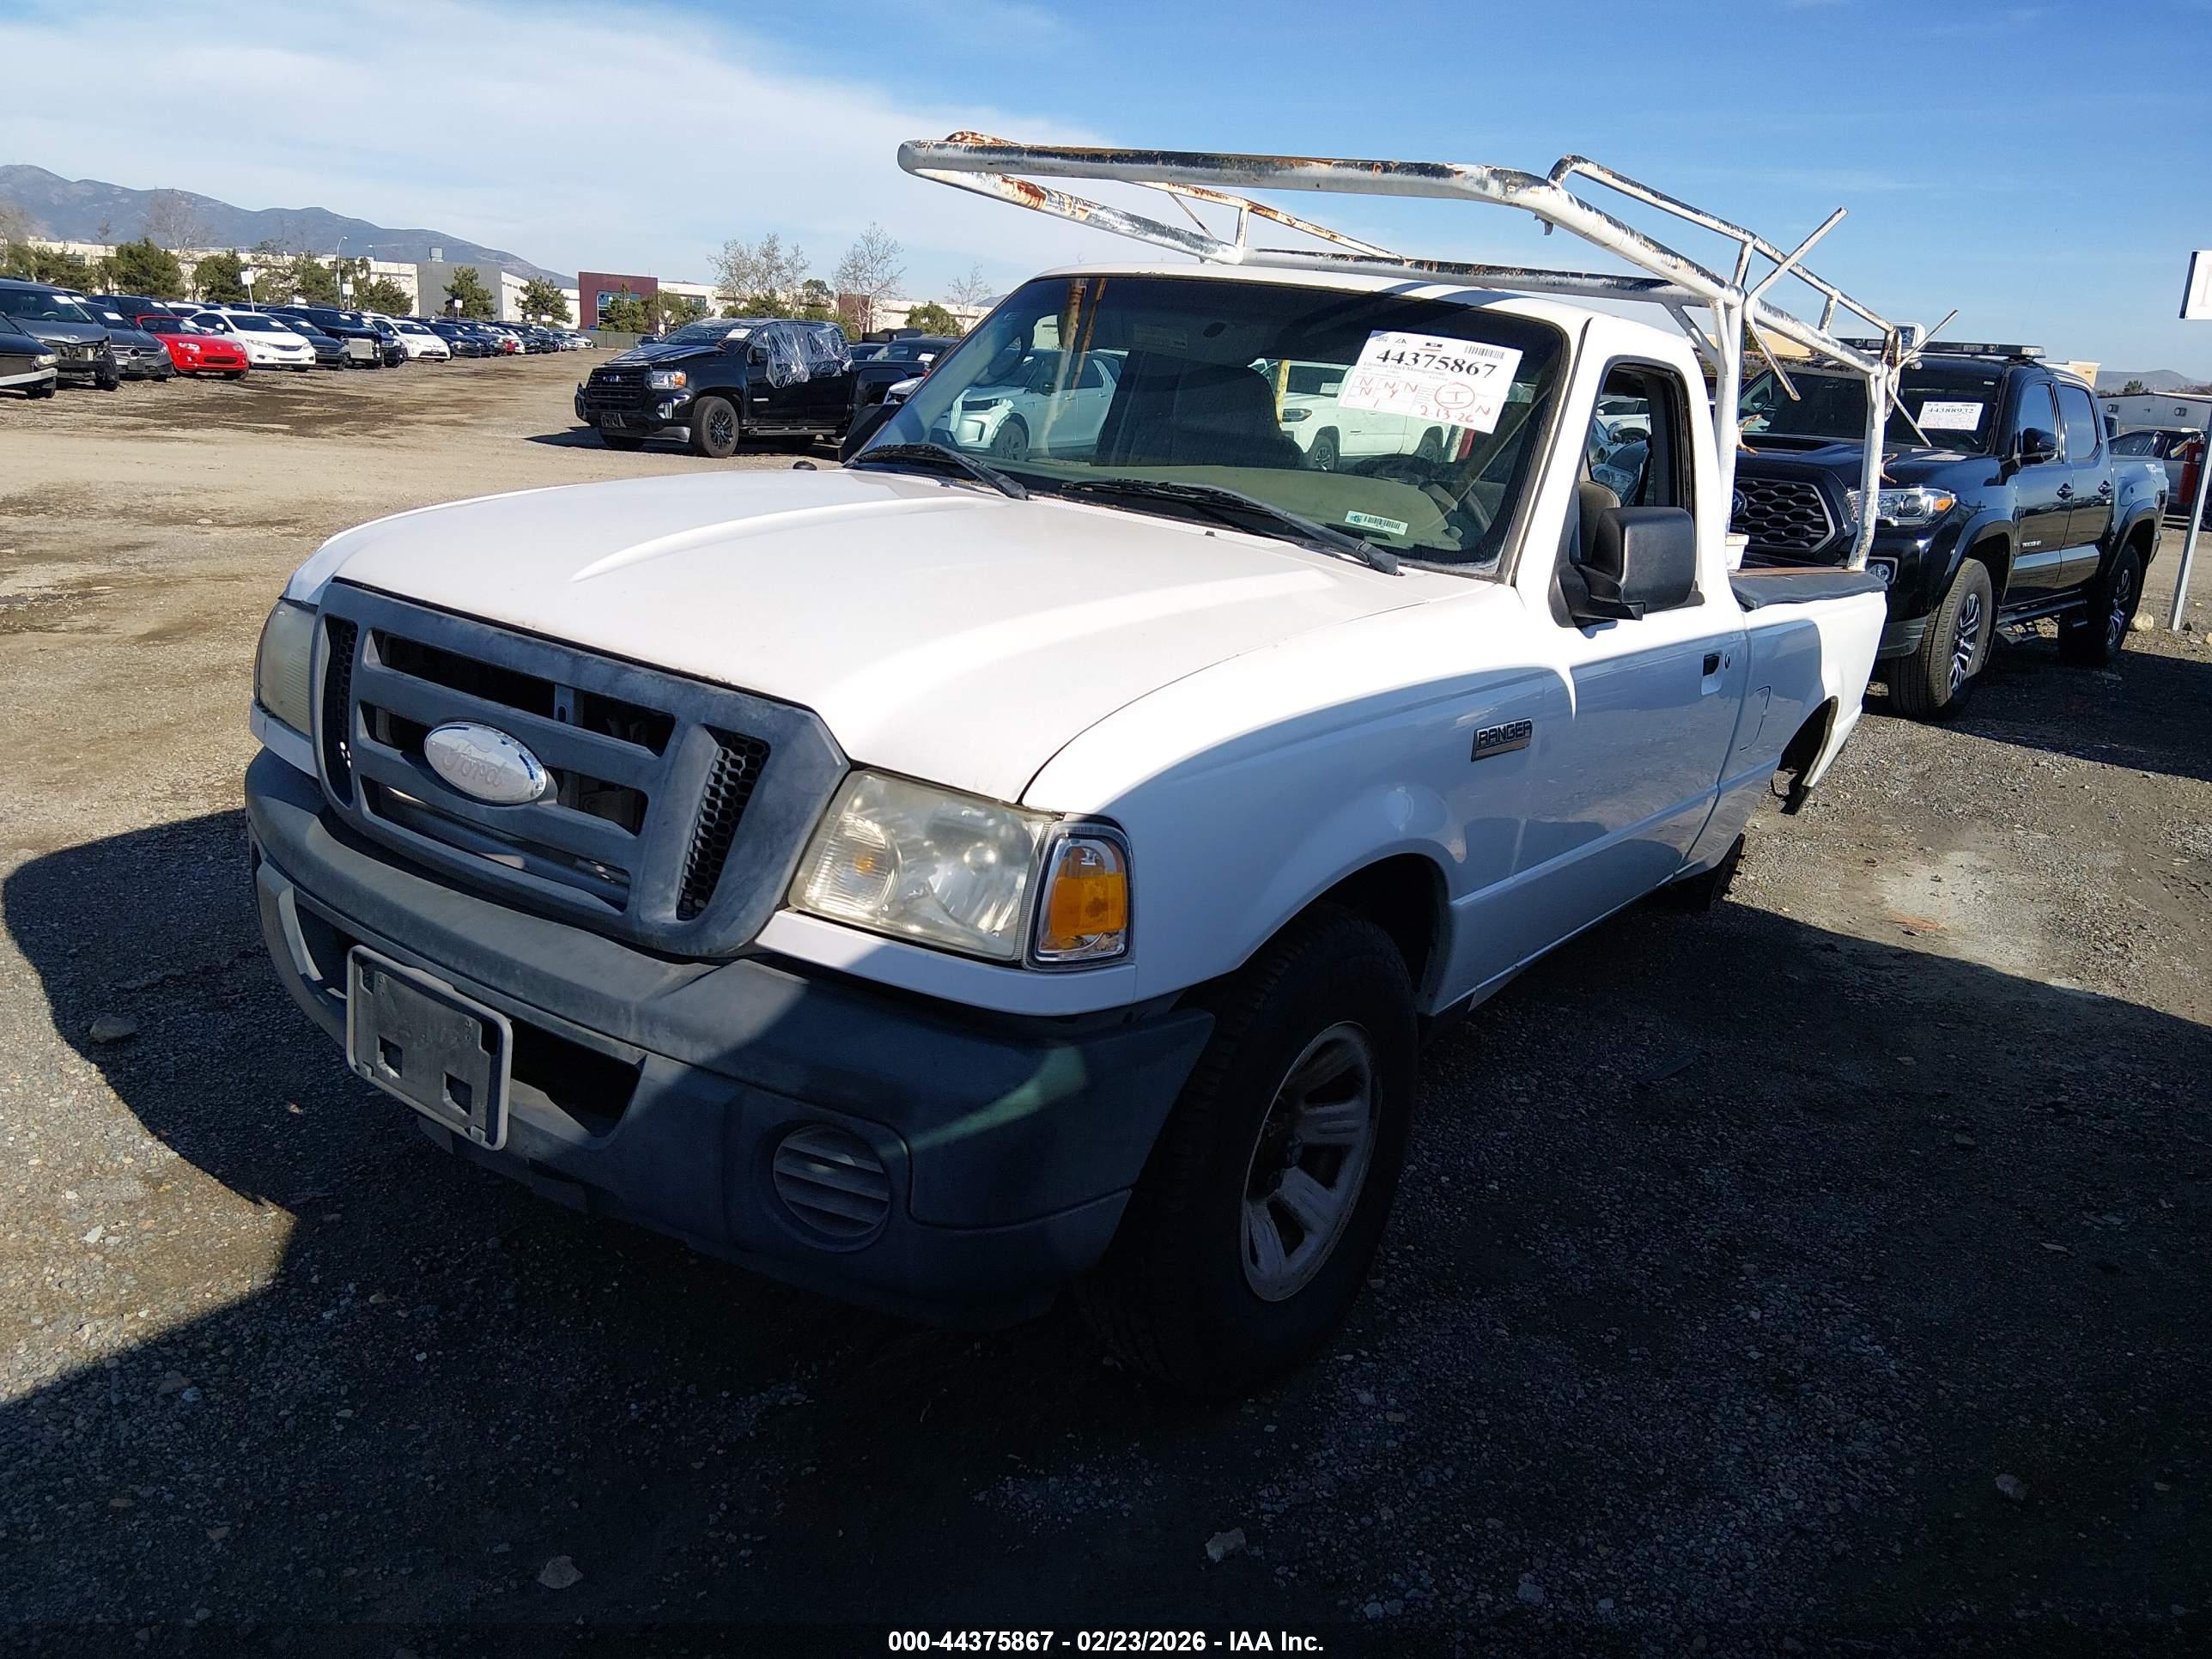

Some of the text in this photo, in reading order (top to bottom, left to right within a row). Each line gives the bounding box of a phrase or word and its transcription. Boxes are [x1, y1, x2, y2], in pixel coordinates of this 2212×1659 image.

[1376, 349, 1498, 379] 44375867
[1477, 720, 1533, 747] RANGER
[441, 737, 508, 787] Ford
